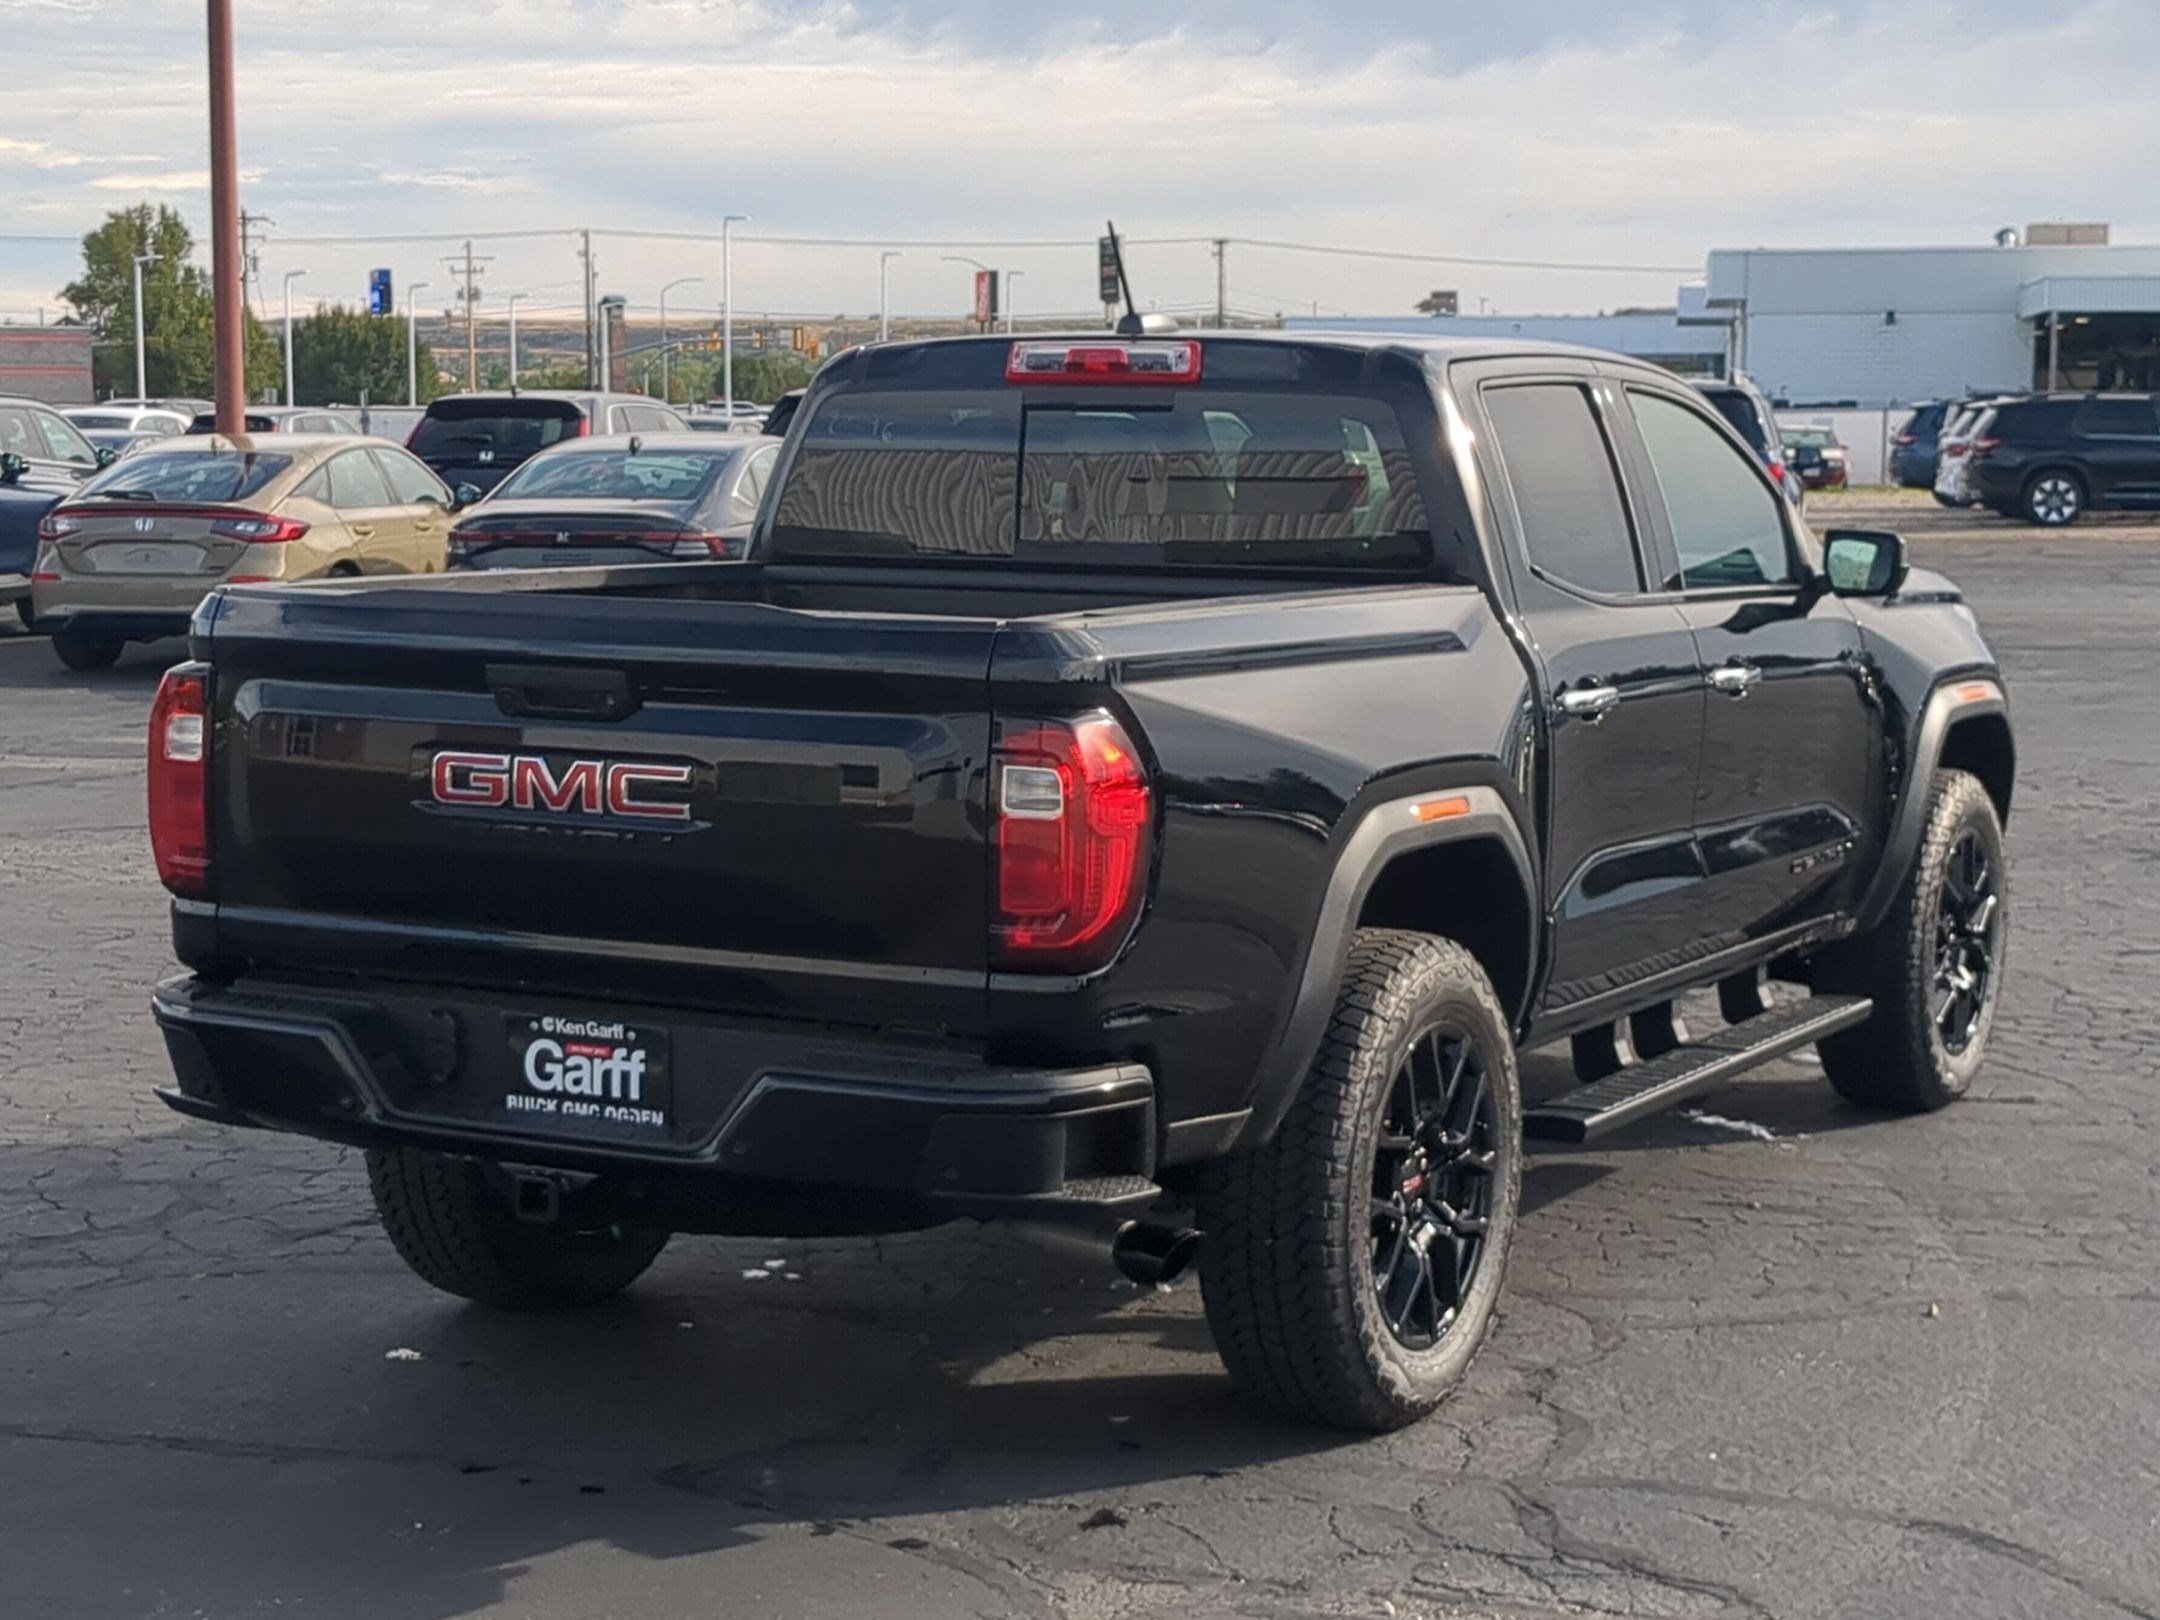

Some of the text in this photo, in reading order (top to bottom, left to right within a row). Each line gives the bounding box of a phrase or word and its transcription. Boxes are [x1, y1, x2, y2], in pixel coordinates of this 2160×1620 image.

[431, 751, 691, 820] GMC
[556, 1017, 624, 1039] Ken Garff
[525, 1038, 645, 1100] Garff
